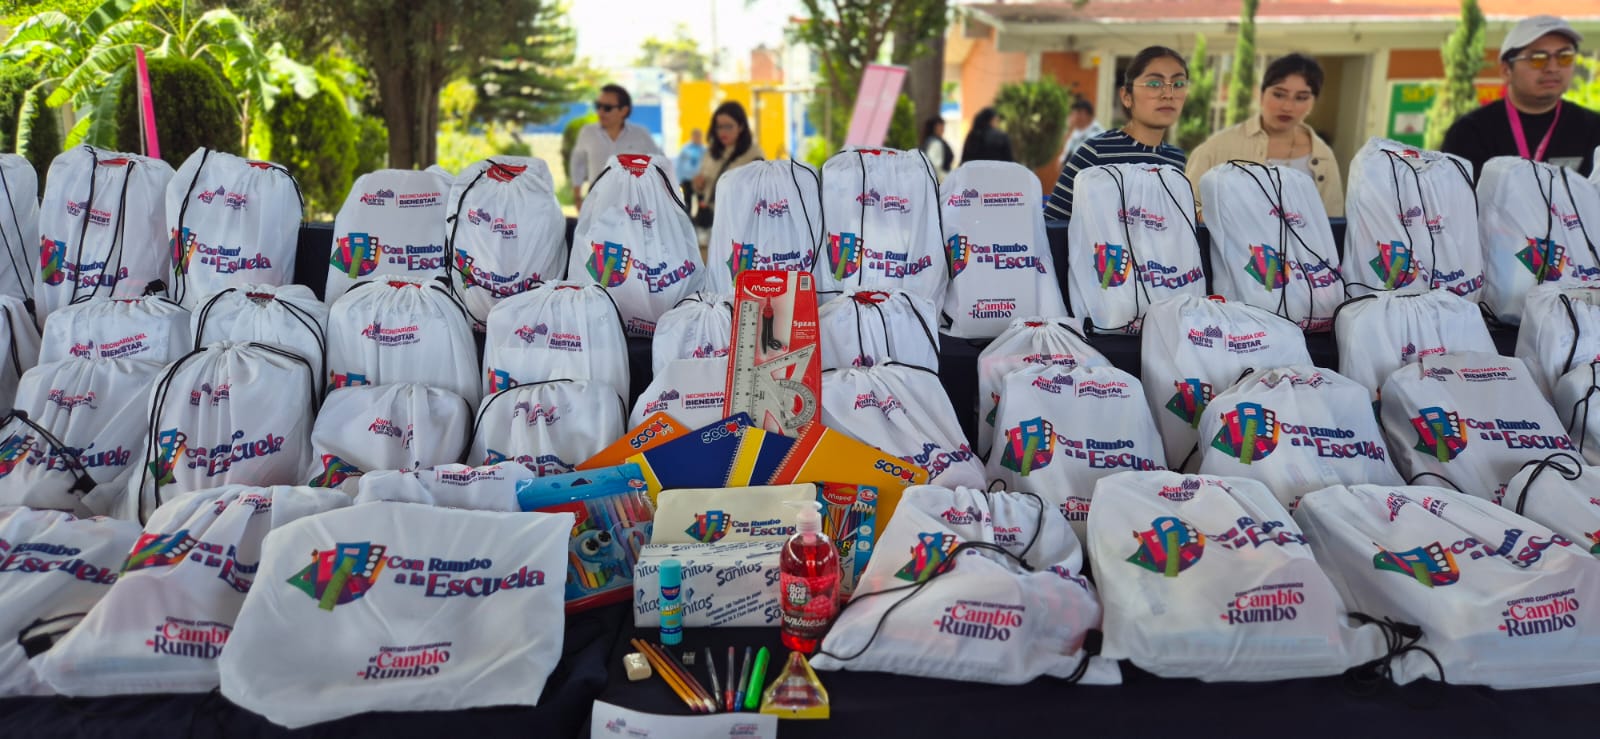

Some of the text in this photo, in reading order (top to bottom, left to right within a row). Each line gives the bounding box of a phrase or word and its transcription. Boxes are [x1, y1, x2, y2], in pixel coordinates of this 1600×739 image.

[382, 244, 442, 254] Con Rumbo
[971, 243, 1028, 253] Con Rumbo
[864, 248, 883, 260] Con
[985, 254, 993, 263] la
[751, 284, 781, 293] Maped
[976, 302, 1016, 311] Cambio
[972, 309, 1011, 319] Rumbo
[1191, 328, 1204, 337] San
[1078, 385, 1122, 395] BIENESTAR
[1079, 380, 1116, 389] SECRETARÍA
[685, 398, 724, 406] BIENESTA
[1466, 418, 1540, 430] Con Rumbo
[1280, 422, 1354, 438] Con Rumbo
[1057, 434, 1134, 449] Con Rumbo
[1291, 437, 1299, 446] a
[1480, 433, 1489, 441] a
[1491, 431, 1503, 441] la
[1065, 449, 1072, 457] a
[1075, 449, 1087, 459] la
[1162, 485, 1181, 493] San
[827, 492, 853, 501] Maped
[732, 518, 782, 528] Con Rumbo
[387, 555, 492, 574] Con Rumbo
[716, 561, 763, 587] Sanitas
[394, 566, 545, 598] a la Escuela
[1235, 589, 1305, 610] Cambio
[1509, 597, 1580, 621] Cambio
[951, 604, 1023, 628] Cambio
[1228, 605, 1297, 625] Rumbo
[939, 615, 1011, 642] Rumbo
[1505, 614, 1576, 637] Rumbo
[163, 622, 232, 645] Cambi
[376, 648, 451, 669] Cambio
[363, 664, 440, 680] Rumbo
